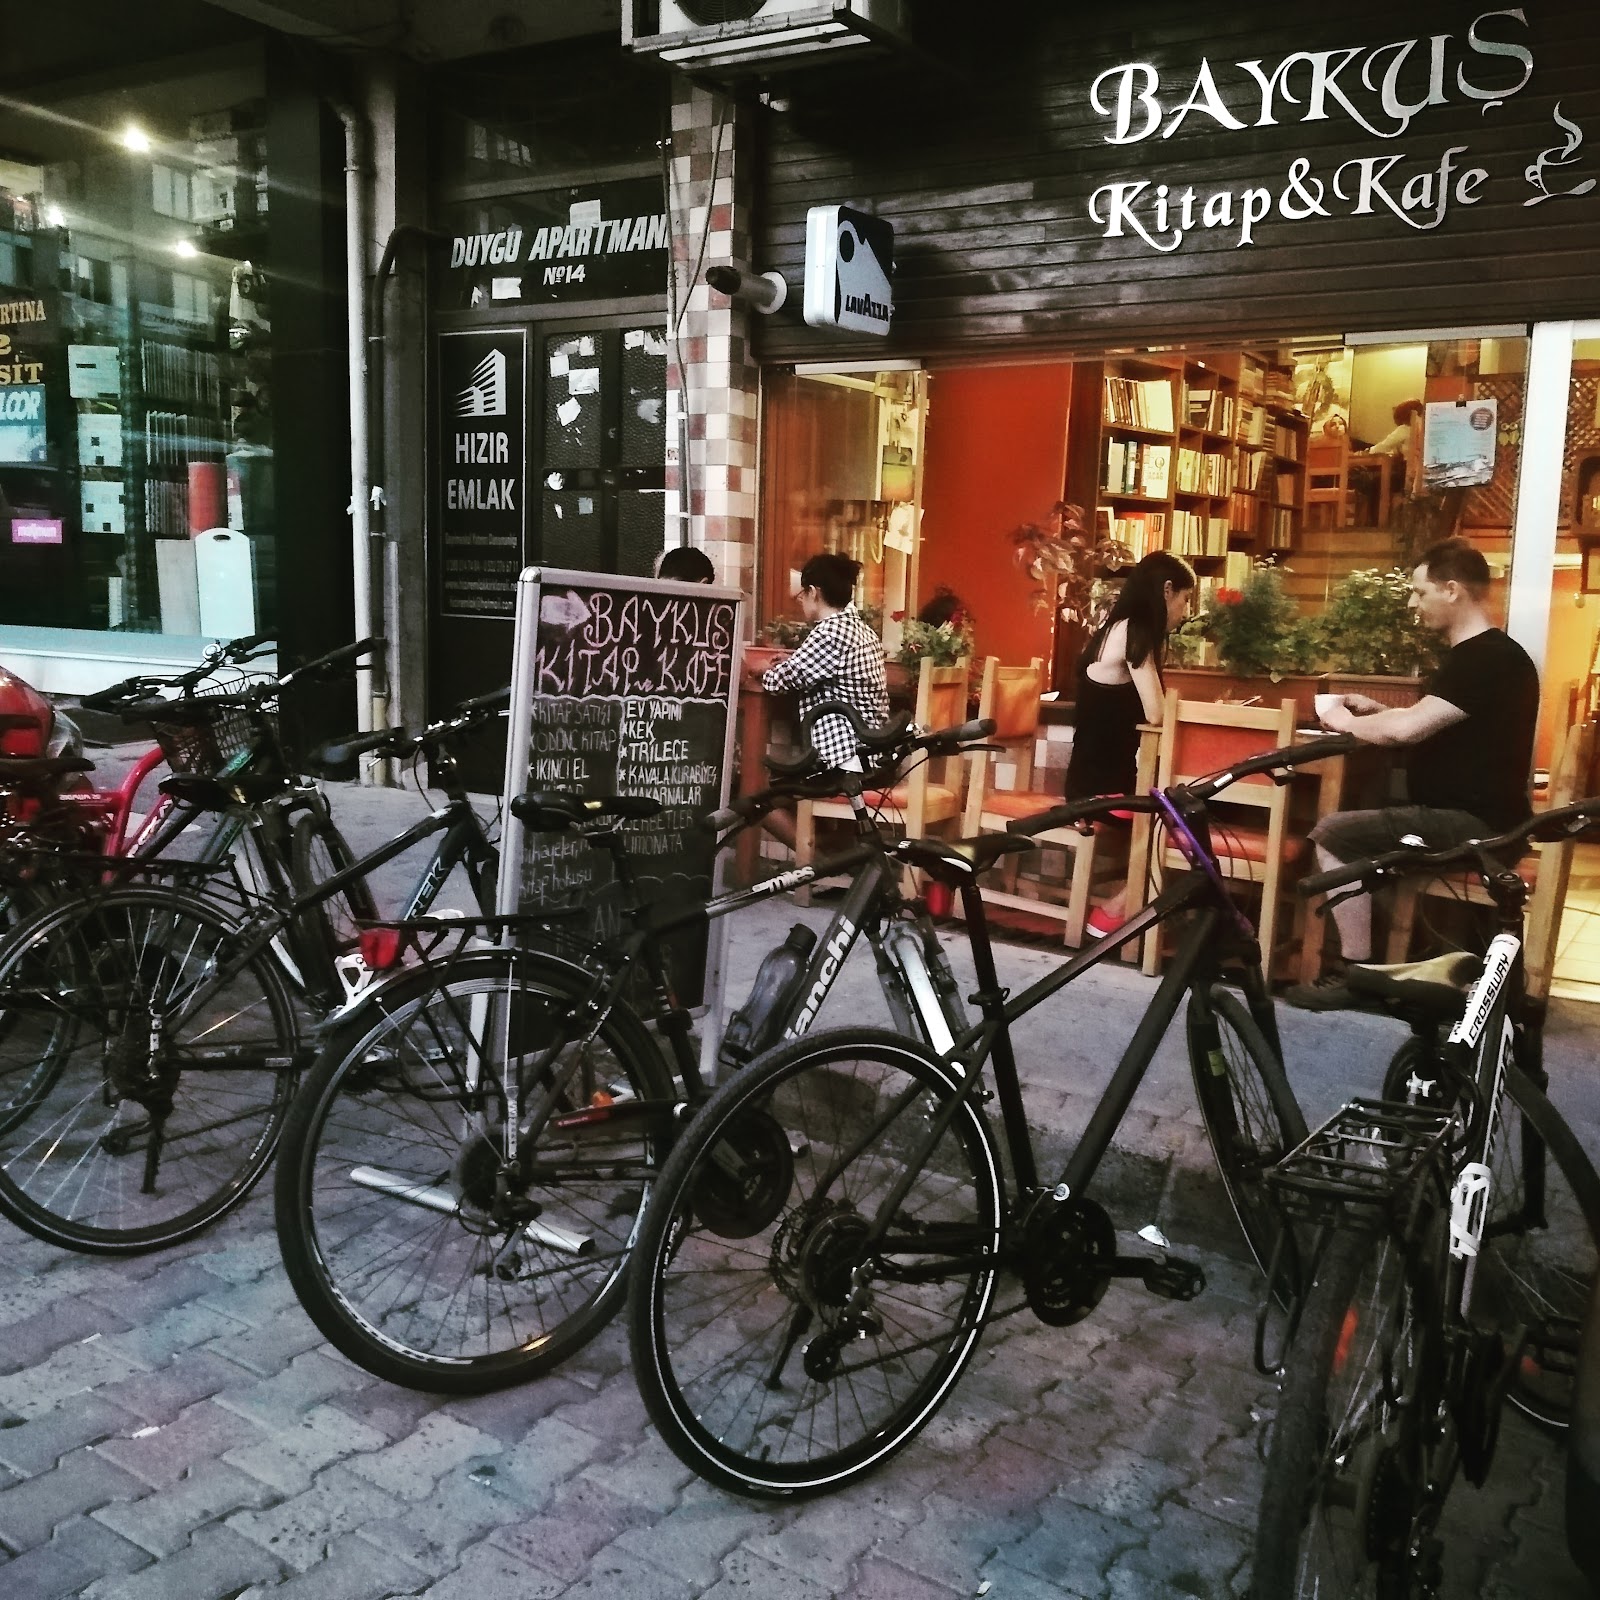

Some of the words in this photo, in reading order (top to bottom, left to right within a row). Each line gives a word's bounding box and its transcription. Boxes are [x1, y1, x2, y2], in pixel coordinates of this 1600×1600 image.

[1090, 8, 1535, 145] BAYKUŞ
[450, 229, 523, 269] DUYGU
[844, 293, 889, 322] LAVAZZA
[455, 431, 509, 466] HIZIR
[447, 478, 515, 512] EMLAK
[627, 701, 646, 719] EV
[573, 757, 590, 781] EL
[784, 914, 856, 1040] ianchi
[1468, 952, 1510, 1042] CROSSWAY
